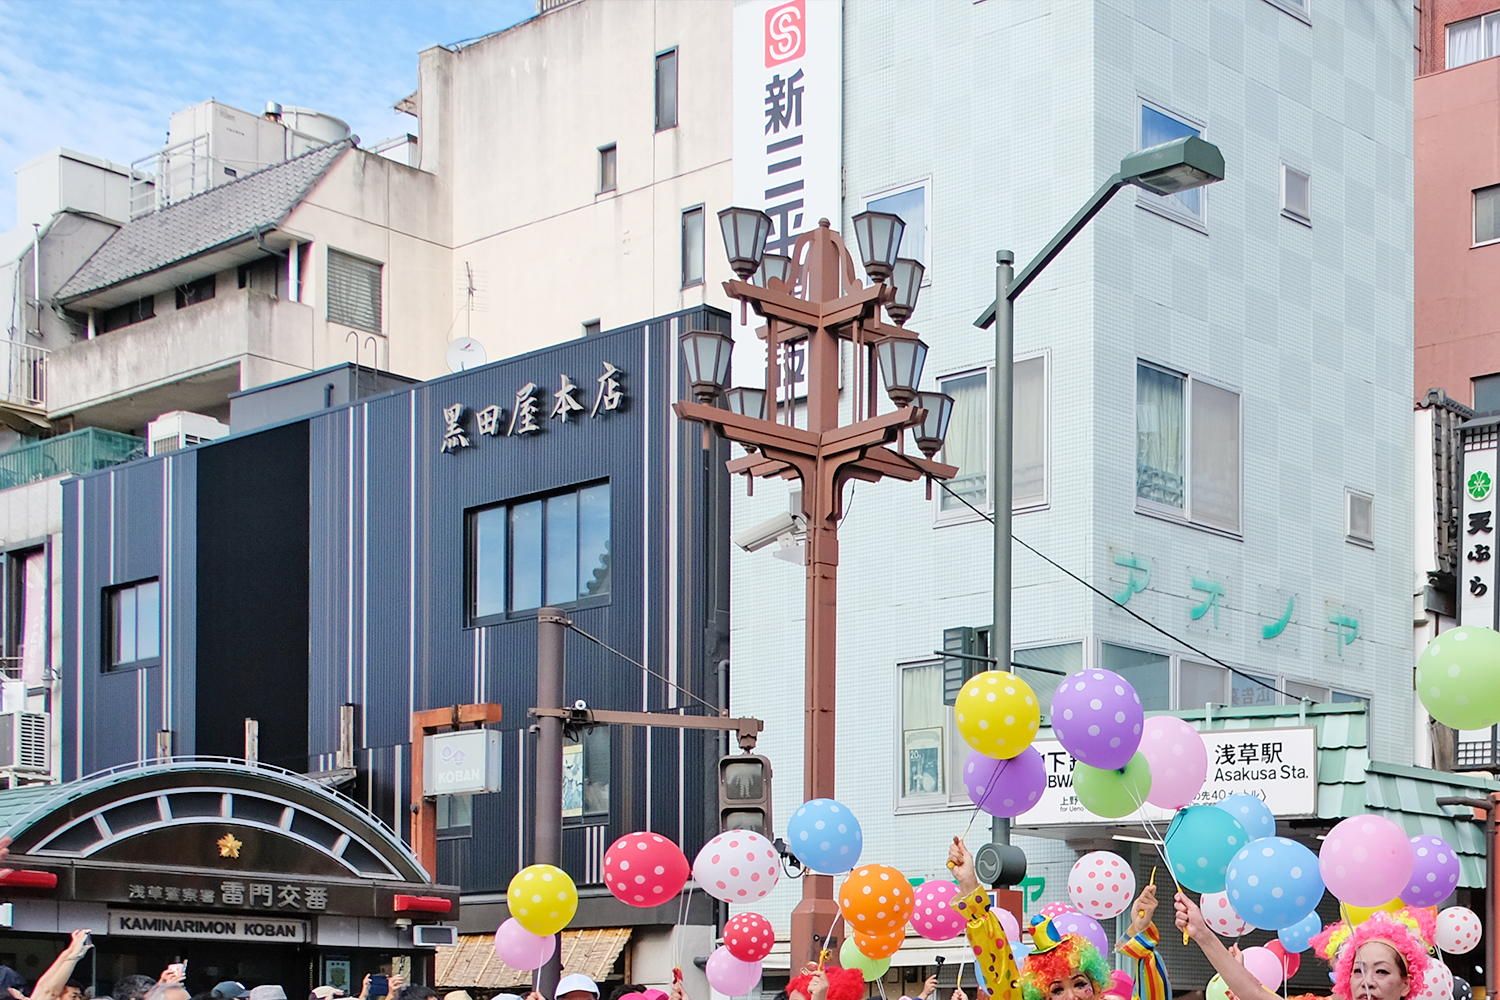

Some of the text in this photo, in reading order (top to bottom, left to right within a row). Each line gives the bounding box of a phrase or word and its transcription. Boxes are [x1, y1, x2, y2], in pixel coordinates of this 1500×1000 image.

[440, 361, 625, 453] 黒田屋本店
[1467, 510, 1494, 597] 天ぷら
[1113, 554, 1359, 656] アオノヤ
[1215, 741, 1284, 765] 浅草駅
[438, 768, 480, 784] KOBAN
[1214, 764, 1309, 782] Asakusa Sta.
[129, 884, 215, 904] 浅草警察署
[220, 881, 329, 910] 雷門交番
[120, 917, 296, 937] KAMINARIMON KOBAN
